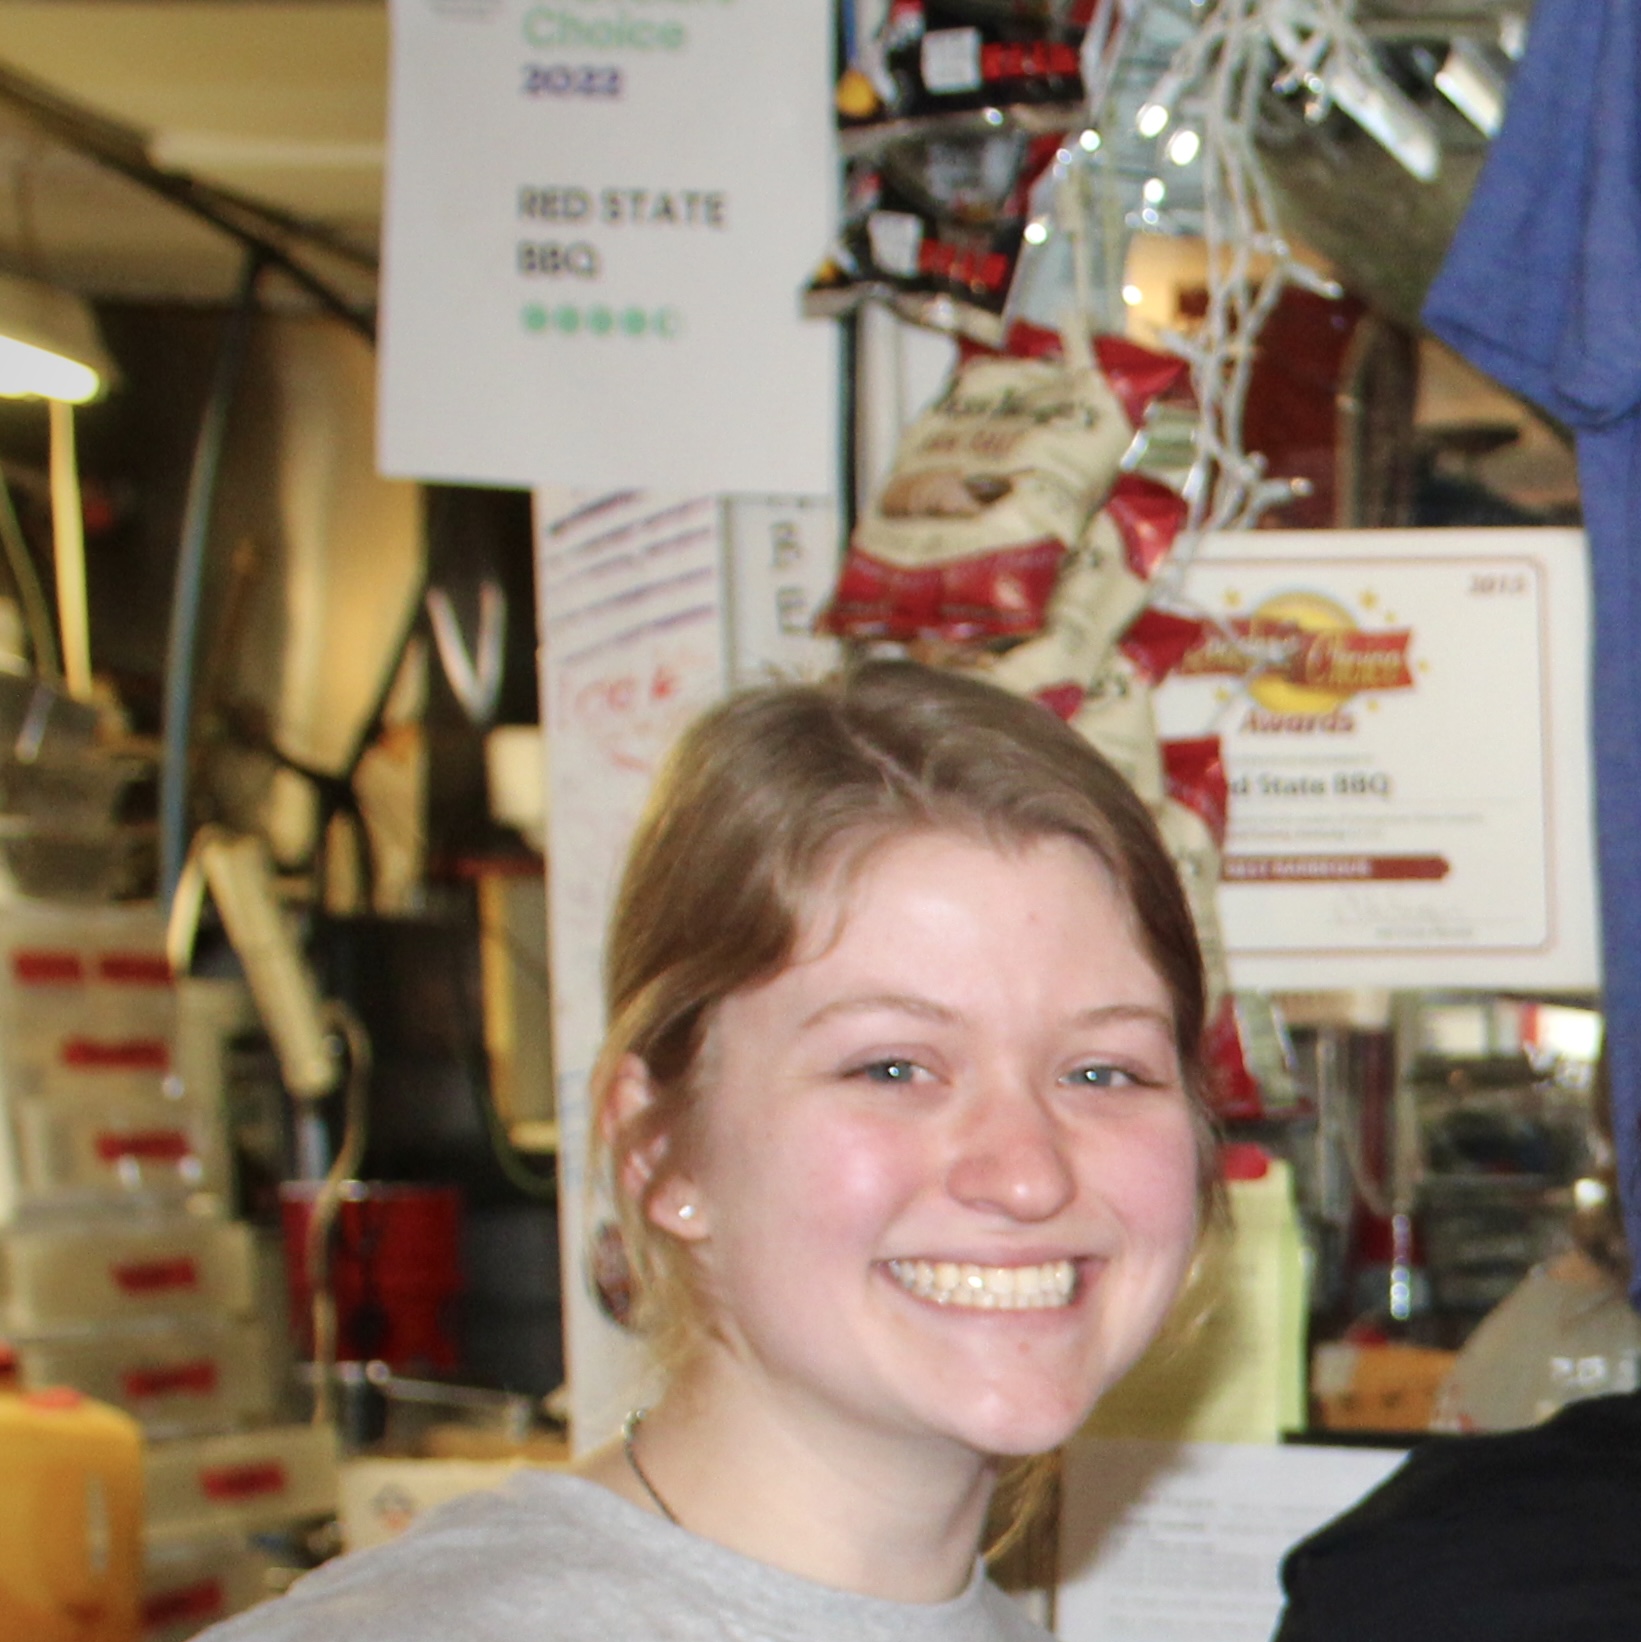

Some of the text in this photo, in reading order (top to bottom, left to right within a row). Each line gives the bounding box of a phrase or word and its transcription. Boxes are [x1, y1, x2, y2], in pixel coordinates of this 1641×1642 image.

[522, 7, 688, 49] Choice
[517, 185, 727, 227] RED STATE
[516, 241, 601, 279] BBQ
[1258, 773, 1326, 796] State
[1333, 772, 1392, 799] BBQ
